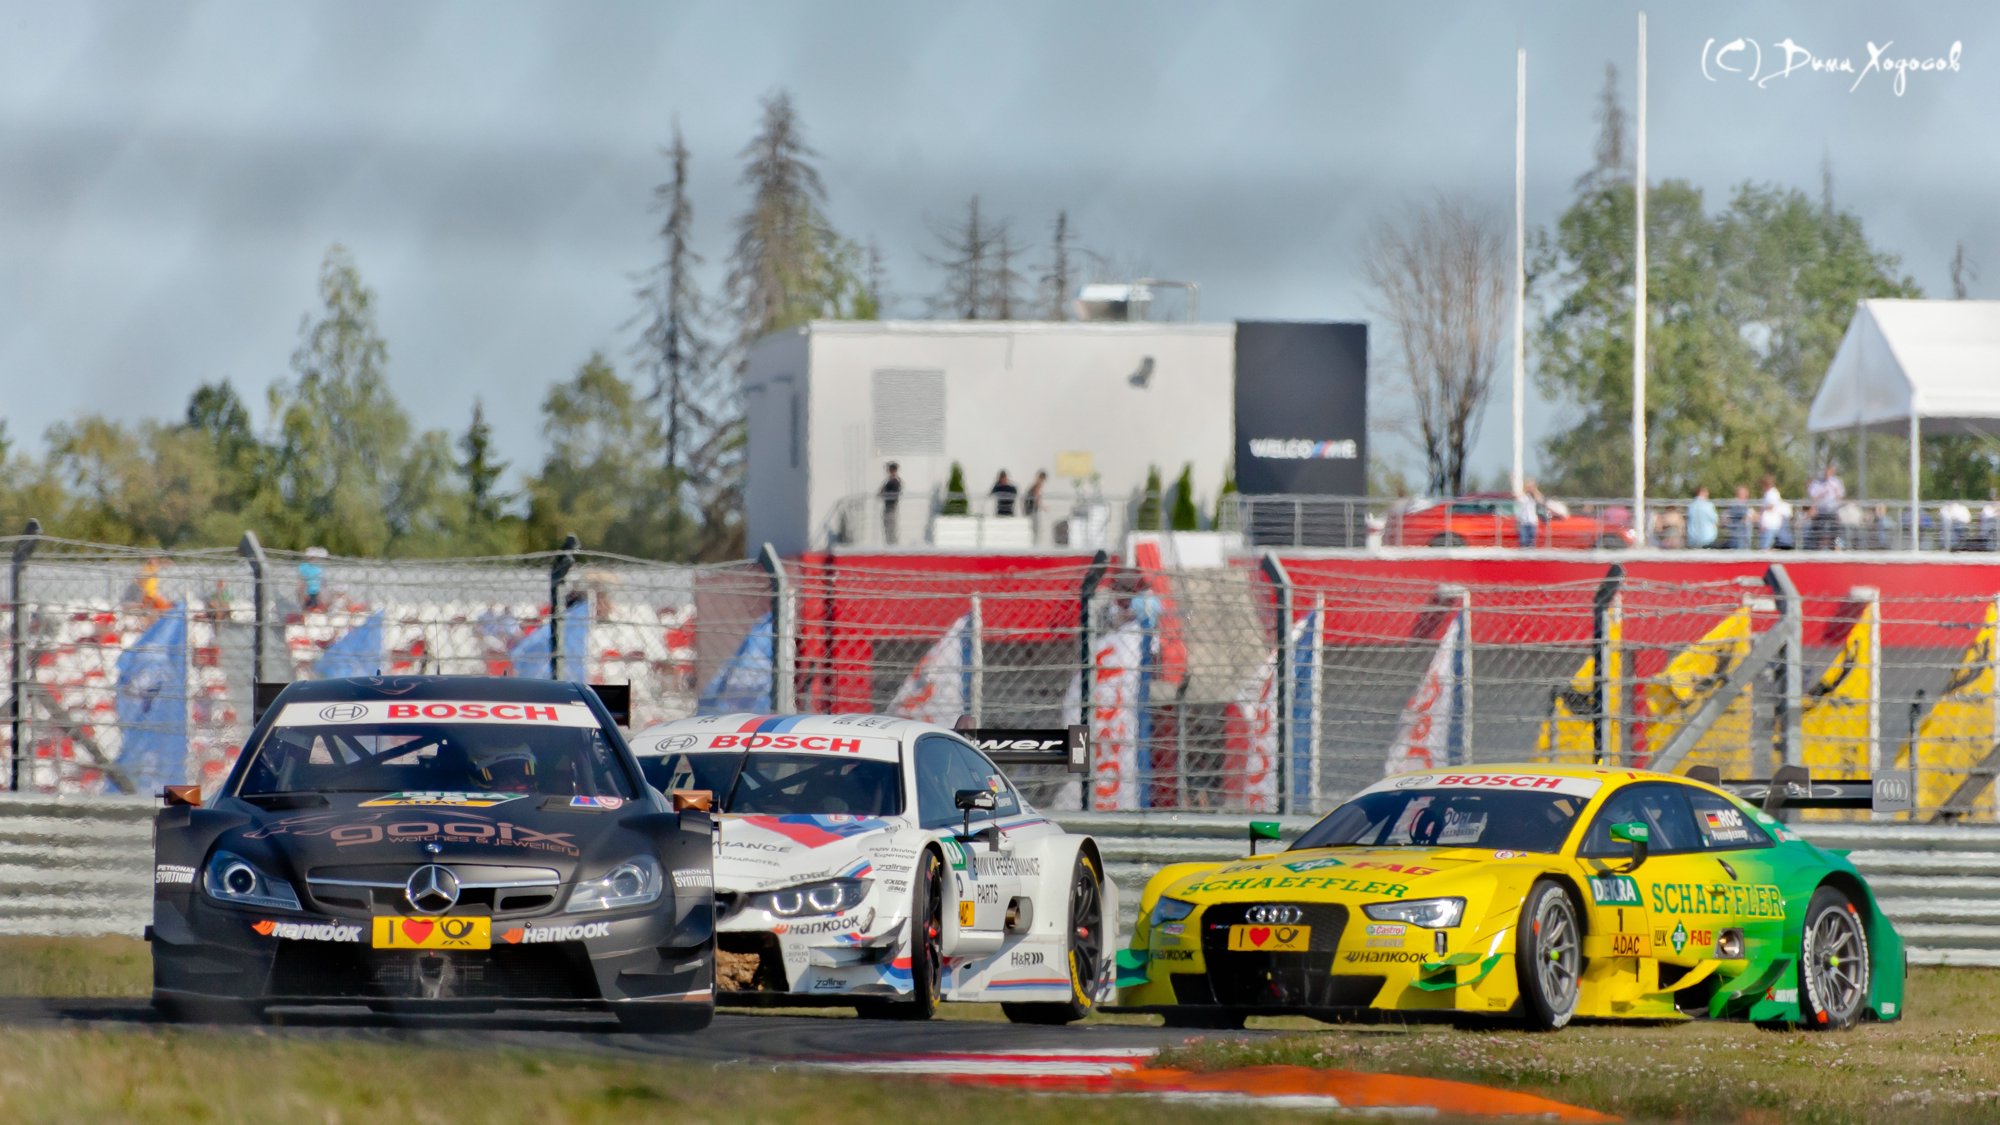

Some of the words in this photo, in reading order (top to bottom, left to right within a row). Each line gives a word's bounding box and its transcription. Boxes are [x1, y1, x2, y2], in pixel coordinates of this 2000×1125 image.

[387, 704, 558, 721] BOSCH
[709, 735, 861, 753] BOSCH
[1436, 776, 1562, 789] BOSCH
[1719, 809, 1743, 827] ROC
[331, 822, 577, 848] gooix
[388, 834, 469, 843] watches
[477, 836, 489, 844] &
[157, 864, 196, 873] PETRONAS
[973, 856, 989, 876] BMW
[1352, 862, 1441, 876] FAG
[155, 871, 194, 884] SYNTIUM
[674, 875, 712, 888] SYNTIUM
[789, 869, 830, 882] EDGE
[977, 884, 998, 904] PARTS
[1181, 876, 1409, 898] SCHAEFFLER
[1592, 878, 1637, 901] DEKRA
[1652, 883, 1784, 917] SCHAEFFLER
[1617, 908, 1623, 932] 1
[388, 920, 394, 944] I
[1239, 928, 1245, 947] I
[1374, 925, 1404, 935] Castrol
[1690, 930, 1711, 946] FAG
[1613, 936, 1640, 955] ADAC
[1010, 953, 1031, 966] H&R
